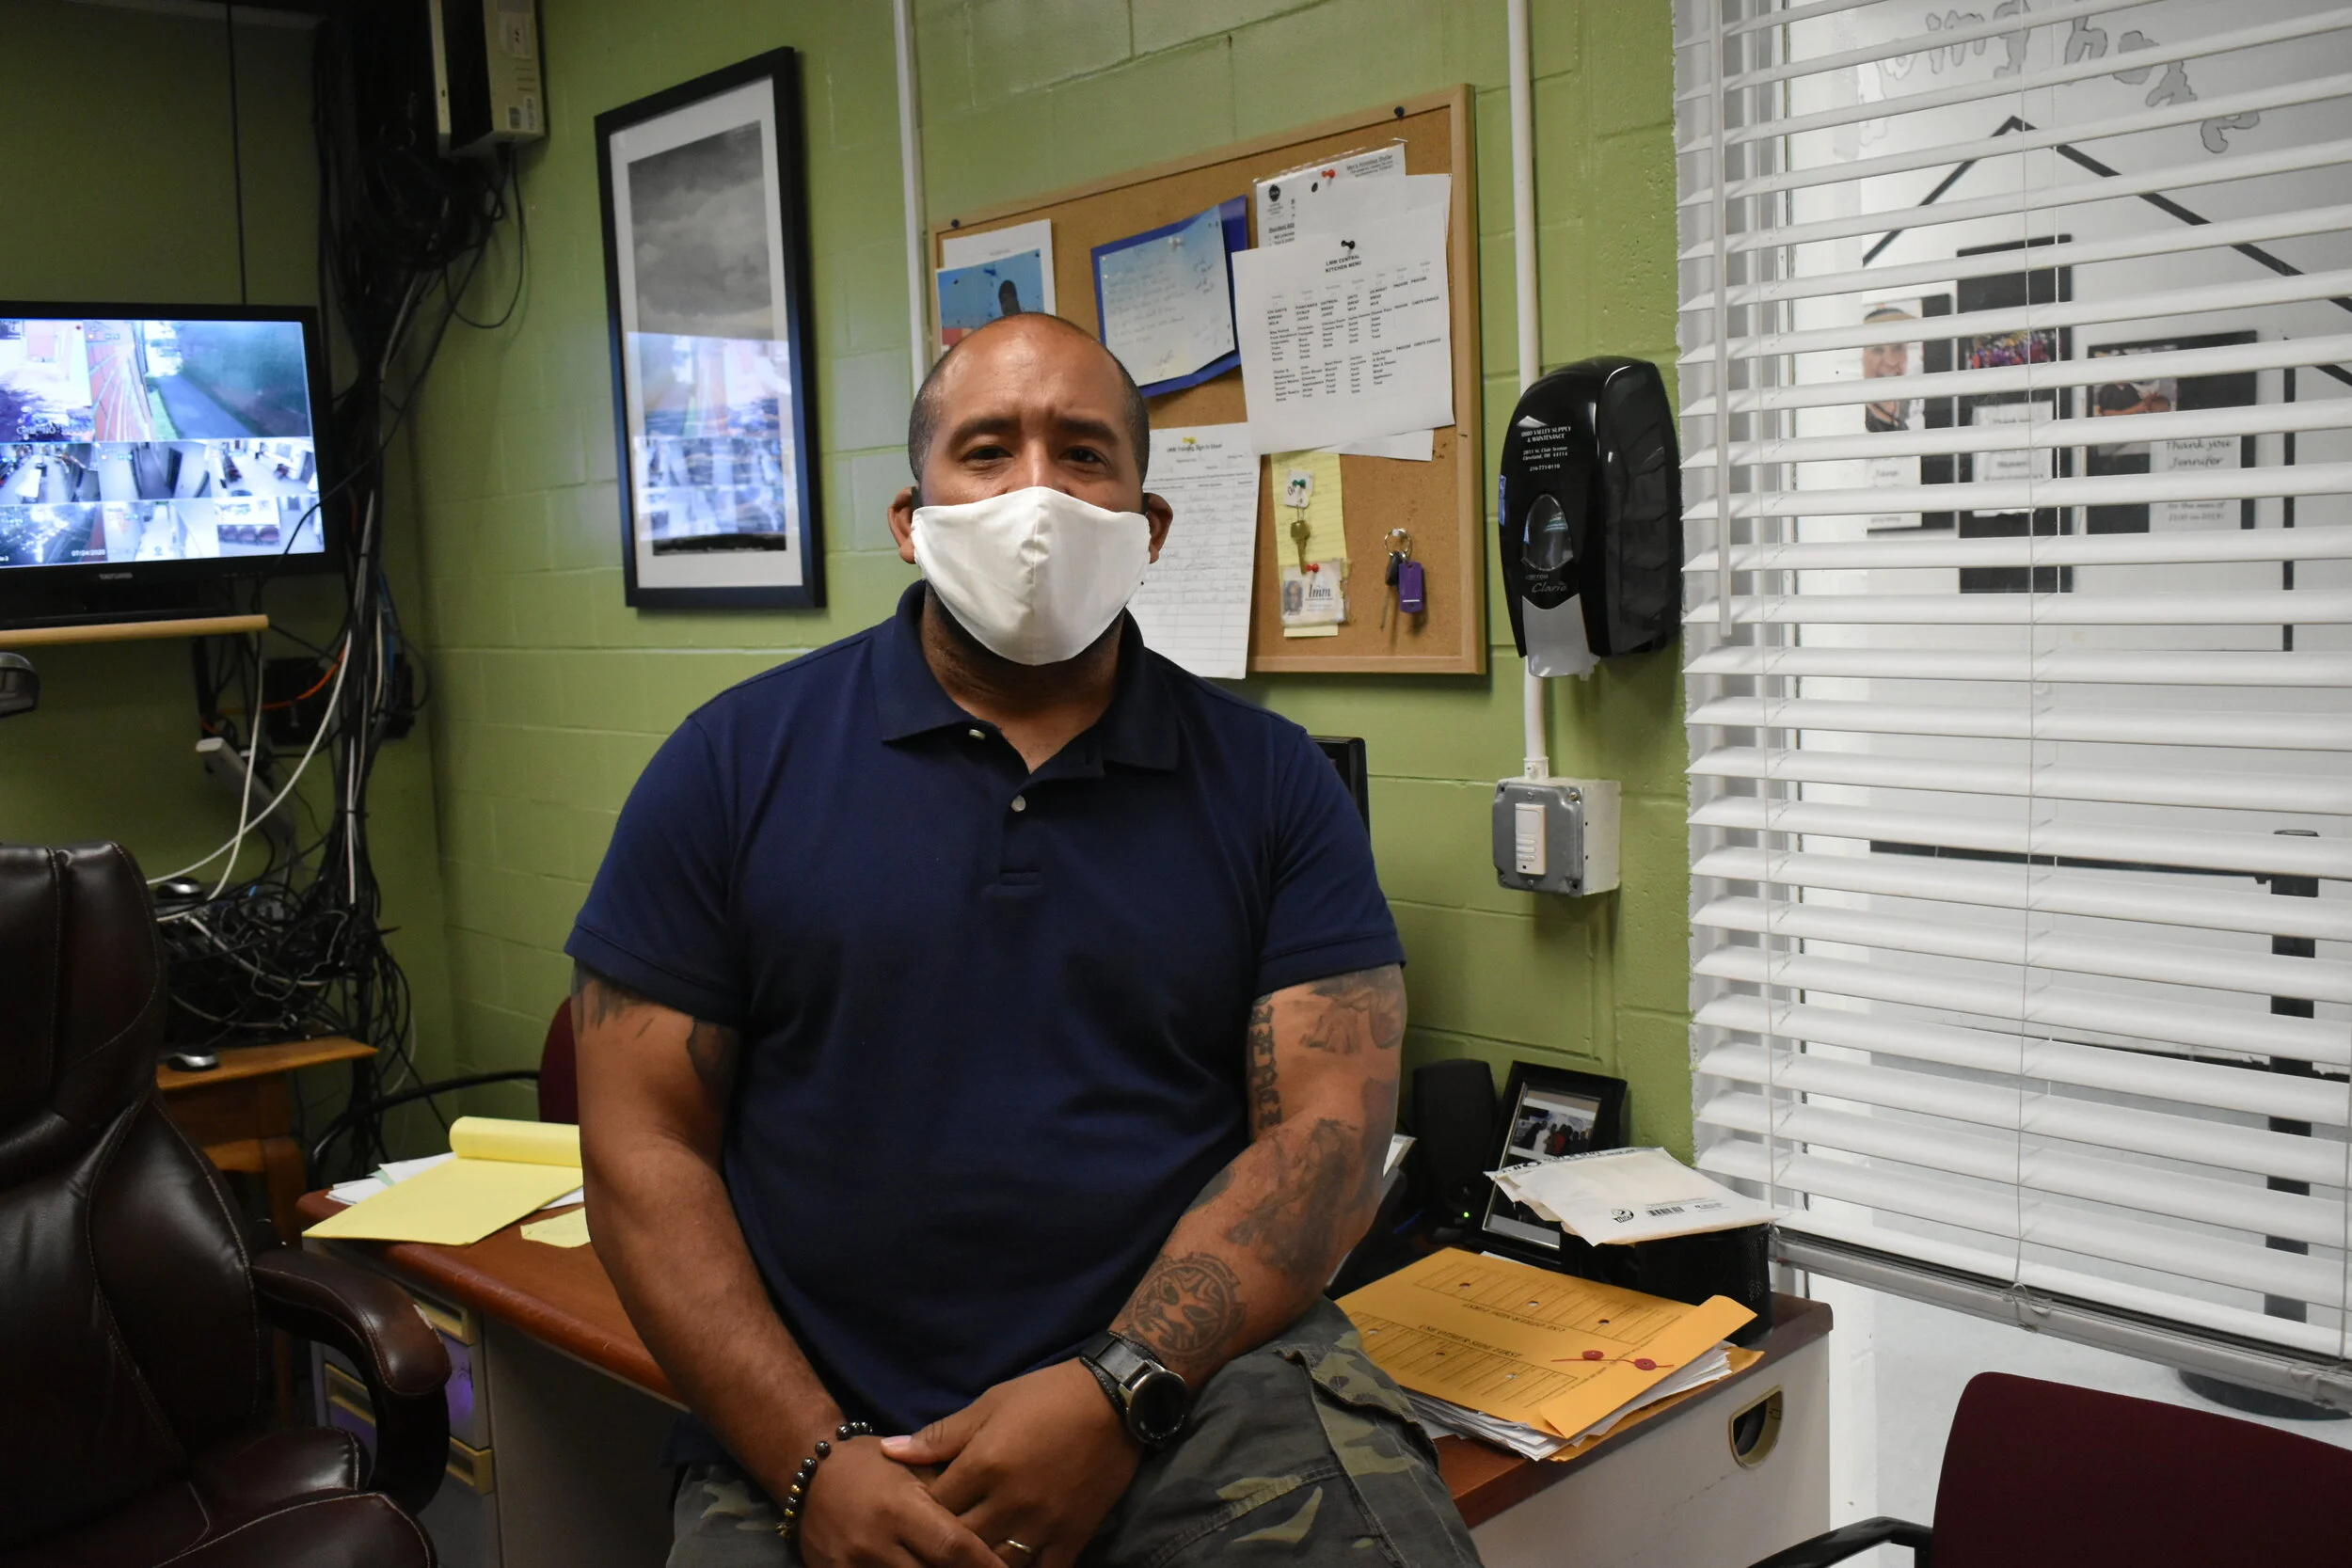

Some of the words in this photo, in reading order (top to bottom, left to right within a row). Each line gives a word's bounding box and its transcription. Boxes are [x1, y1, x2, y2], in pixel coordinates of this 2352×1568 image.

[1338, 254, 1360, 263] CENTRAL
[1325, 264, 1348, 273] KITCHEN
[1348, 260, 1362, 269] MENU
[1532, 433, 1565, 442] MAINTENANCE
[2166, 440, 2203, 450] Thank
[2206, 440, 2230, 451] you
[2170, 455, 2223, 468] Jennifer
